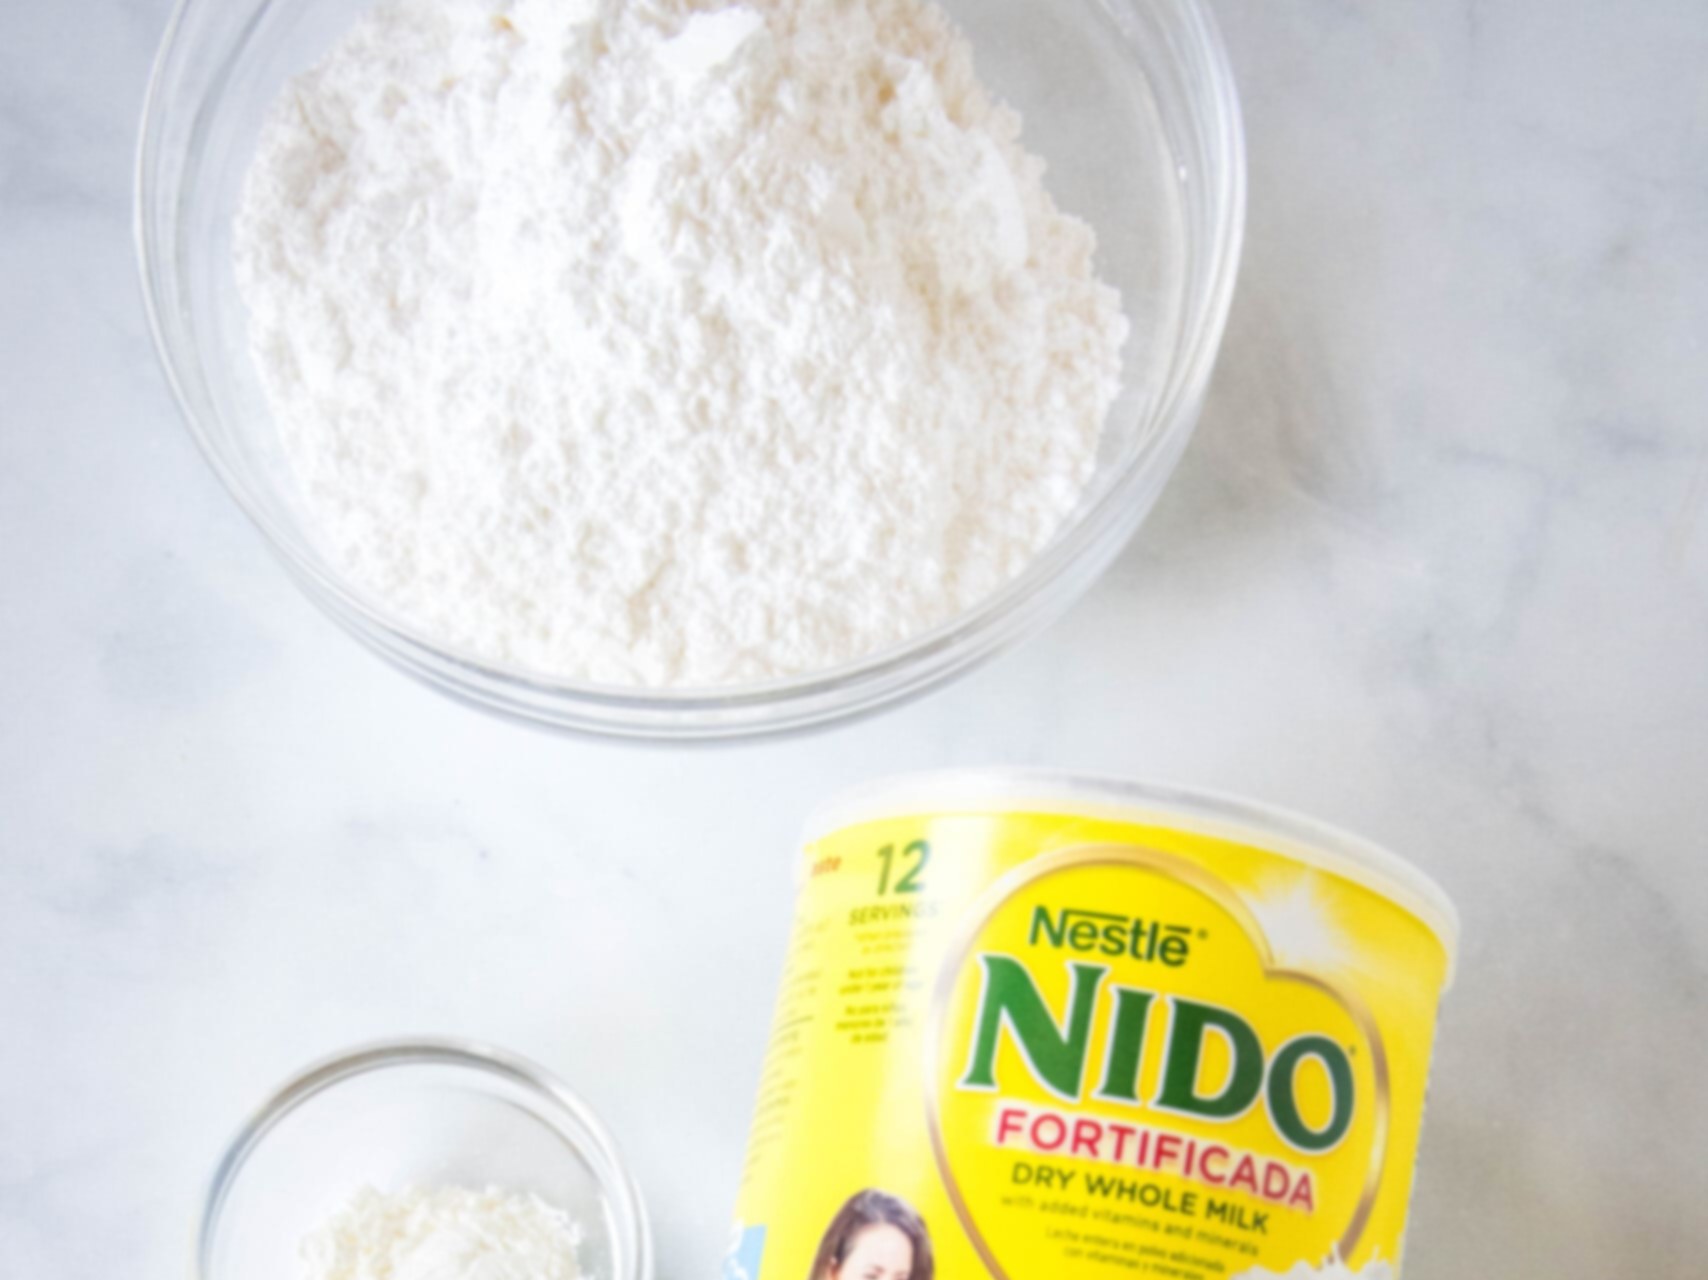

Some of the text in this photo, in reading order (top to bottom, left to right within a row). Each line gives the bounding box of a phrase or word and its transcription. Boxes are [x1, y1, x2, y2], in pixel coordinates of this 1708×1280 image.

[876, 838, 931, 896] 12
[849, 902, 939, 926] SERVINGS
[955, 953, 1356, 1154] NIDO
[996, 1108, 1315, 1212] FORTIFICADA
[1001, 1193, 1259, 1257] with added vitamins and minerals
[1011, 1162, 1270, 1235] DRY WHOLE MILK
